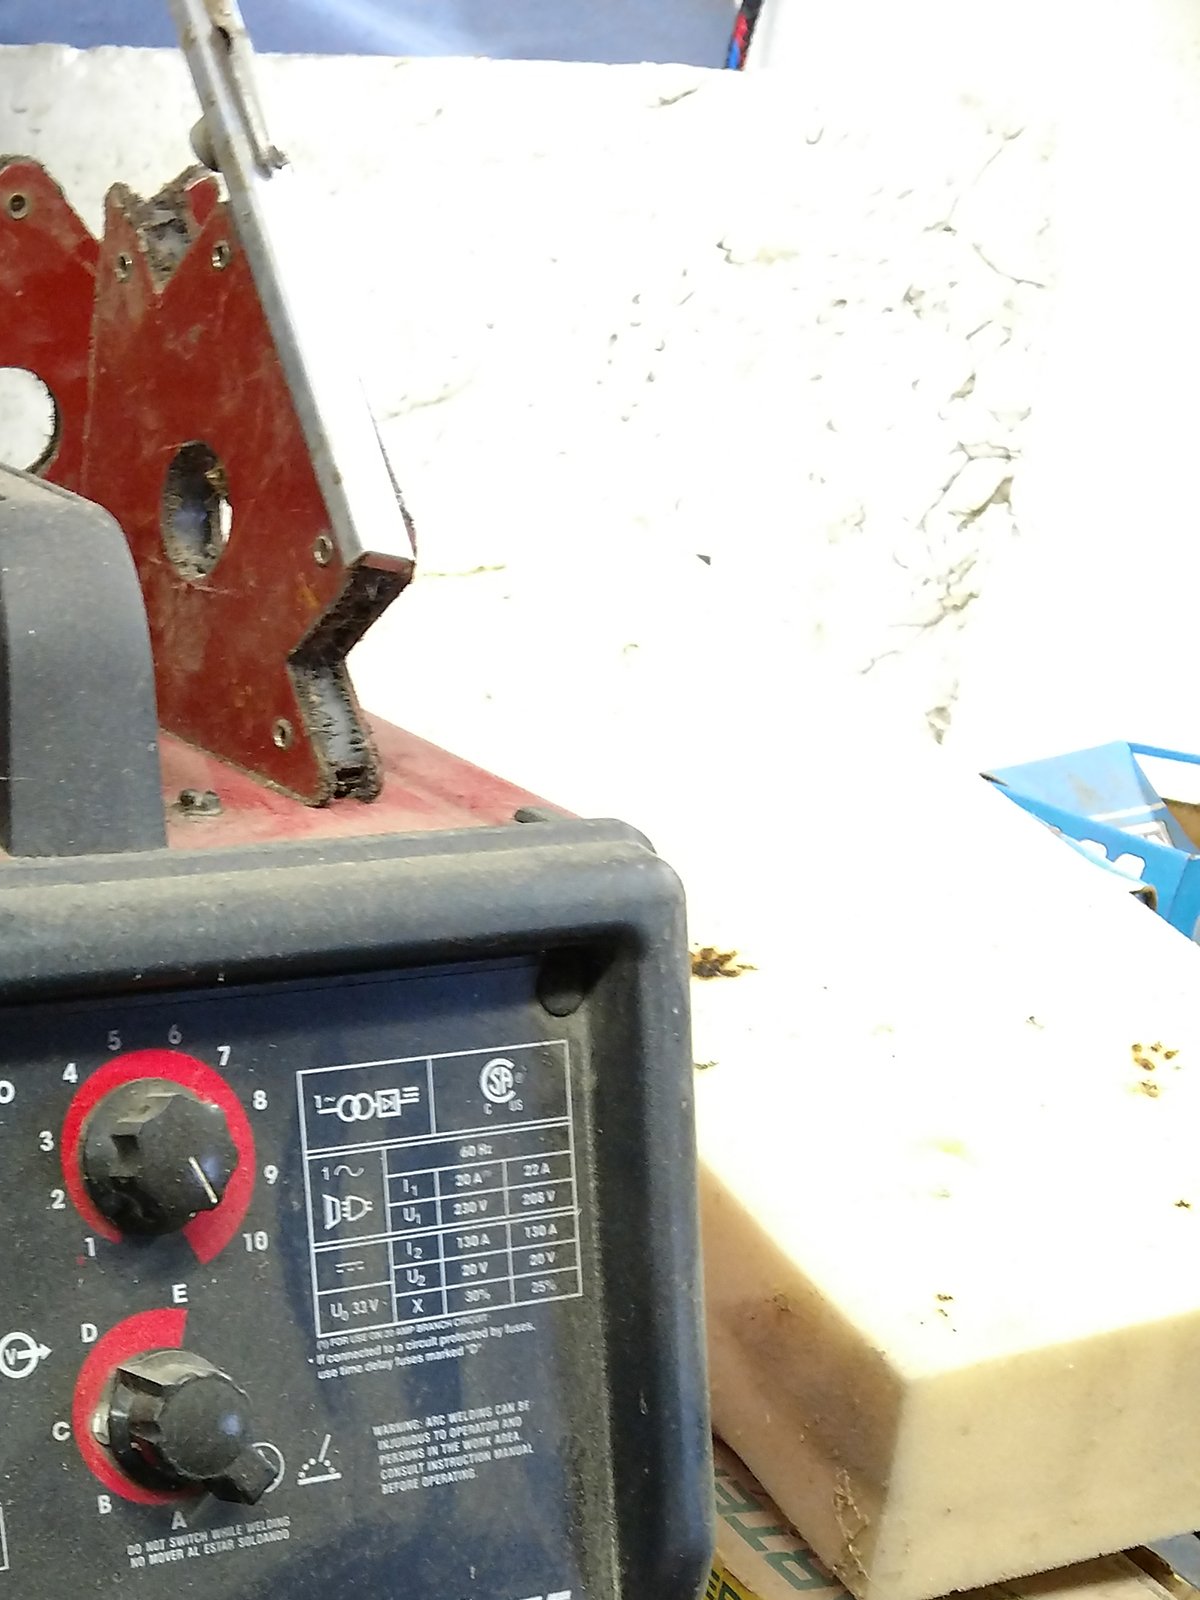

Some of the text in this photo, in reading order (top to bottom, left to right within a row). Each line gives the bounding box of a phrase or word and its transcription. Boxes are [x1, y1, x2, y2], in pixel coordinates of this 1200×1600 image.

[107, 1030, 122, 1050] 5
[168, 1025, 182, 1044] 6
[217, 1046, 231, 1066] 7
[62, 1062, 78, 1083] 4
[253, 1090, 268, 1110] 8
[39, 1131, 54, 1152] 3
[264, 1165, 278, 1184] 9
[51, 1190, 66, 1209] 2
[84, 1237, 96, 1257] 1
[242, 1231, 269, 1251] 10
[172, 1283, 188, 1304] E
[412, 1298, 424, 1313] X
[80, 1324, 97, 1343] D
[52, 1421, 70, 1441] C
[97, 1494, 112, 1514] B
[171, 1510, 187, 1530] A
